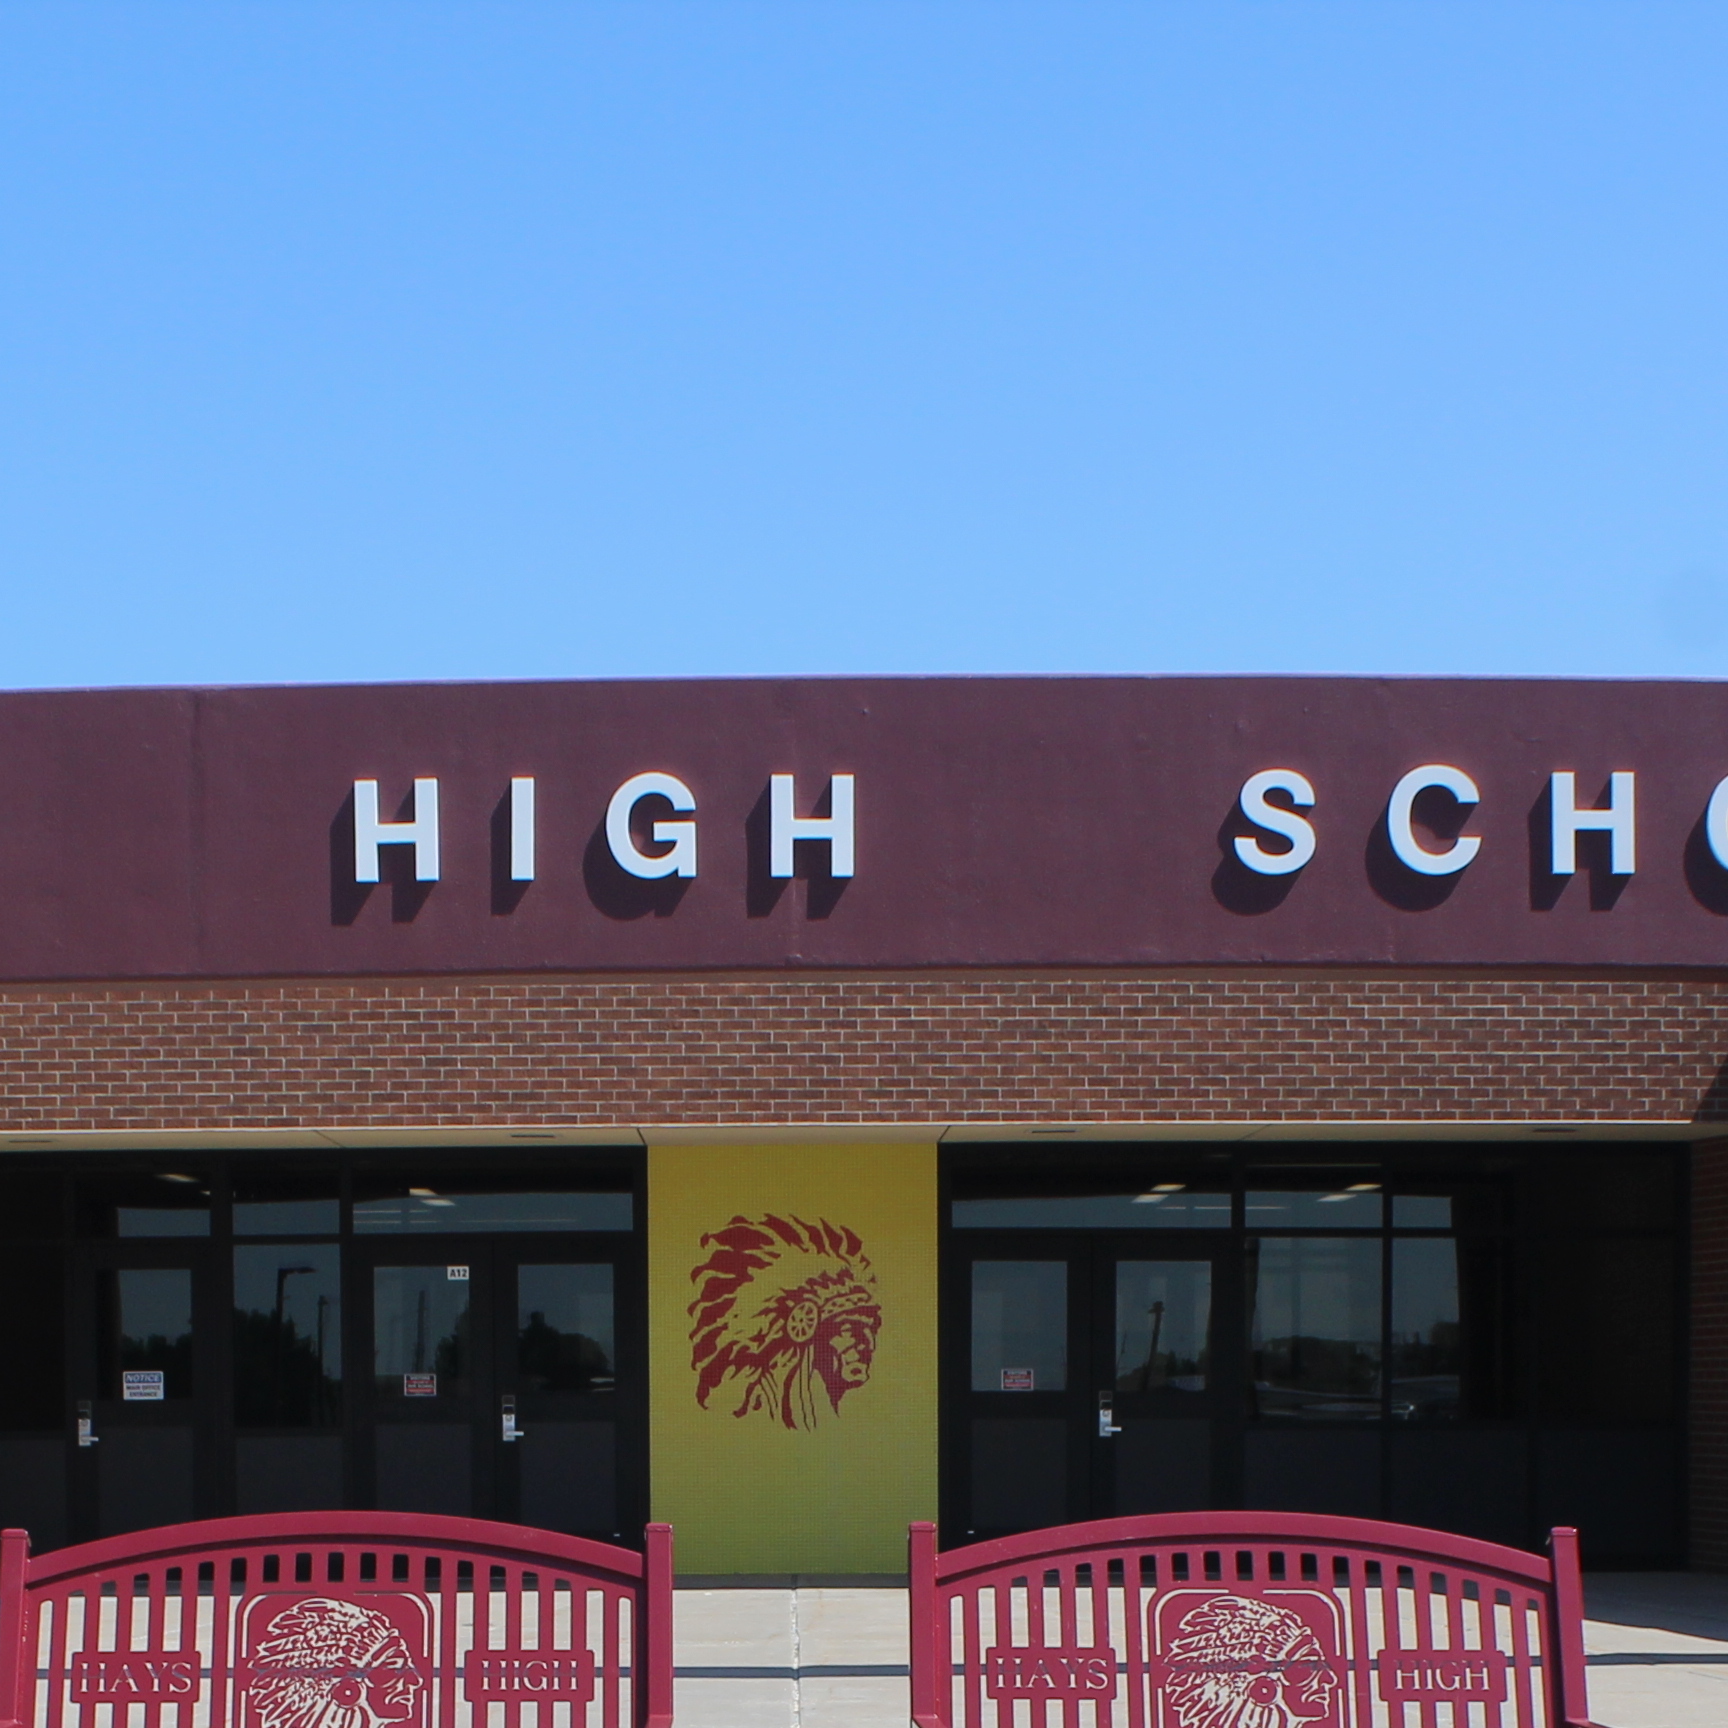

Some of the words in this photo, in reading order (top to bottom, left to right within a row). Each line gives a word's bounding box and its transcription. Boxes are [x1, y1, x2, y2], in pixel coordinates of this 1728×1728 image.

[354, 772, 855, 882] HIGH
[449, 1268, 468, 1279] A12
[126, 1374, 160, 1382] NOTICE
[79, 1661, 193, 1693] HAYS
[481, 1660, 578, 1691] HIGH
[995, 1657, 1109, 1690] HAYS
[1393, 1659, 1490, 1691] HIGH
